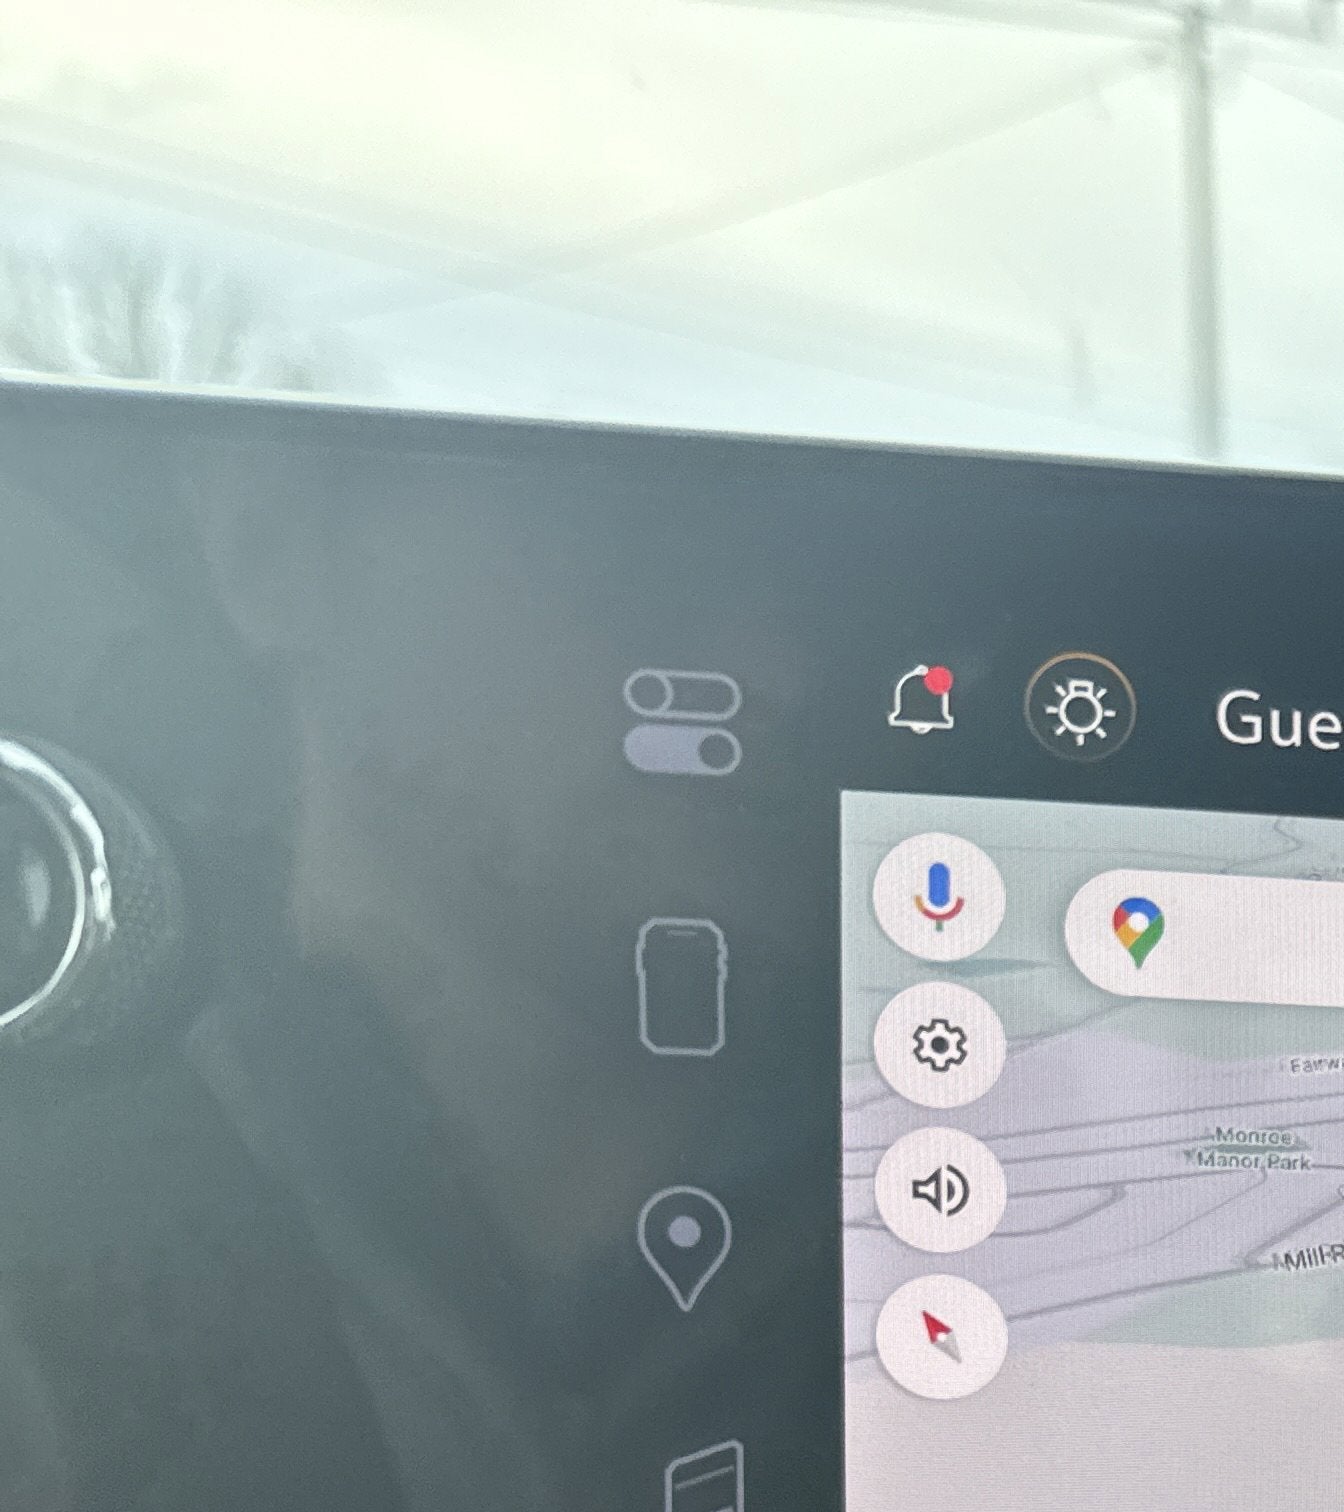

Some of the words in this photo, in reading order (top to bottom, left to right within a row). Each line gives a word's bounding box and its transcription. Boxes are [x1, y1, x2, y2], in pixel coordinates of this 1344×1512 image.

[1215, 1126, 1292, 1145] Monroe
[1198, 1152, 1260, 1168] Manor
[1267, 1153, 1312, 1171] Park
[1284, 1245, 1326, 1272] Mill
